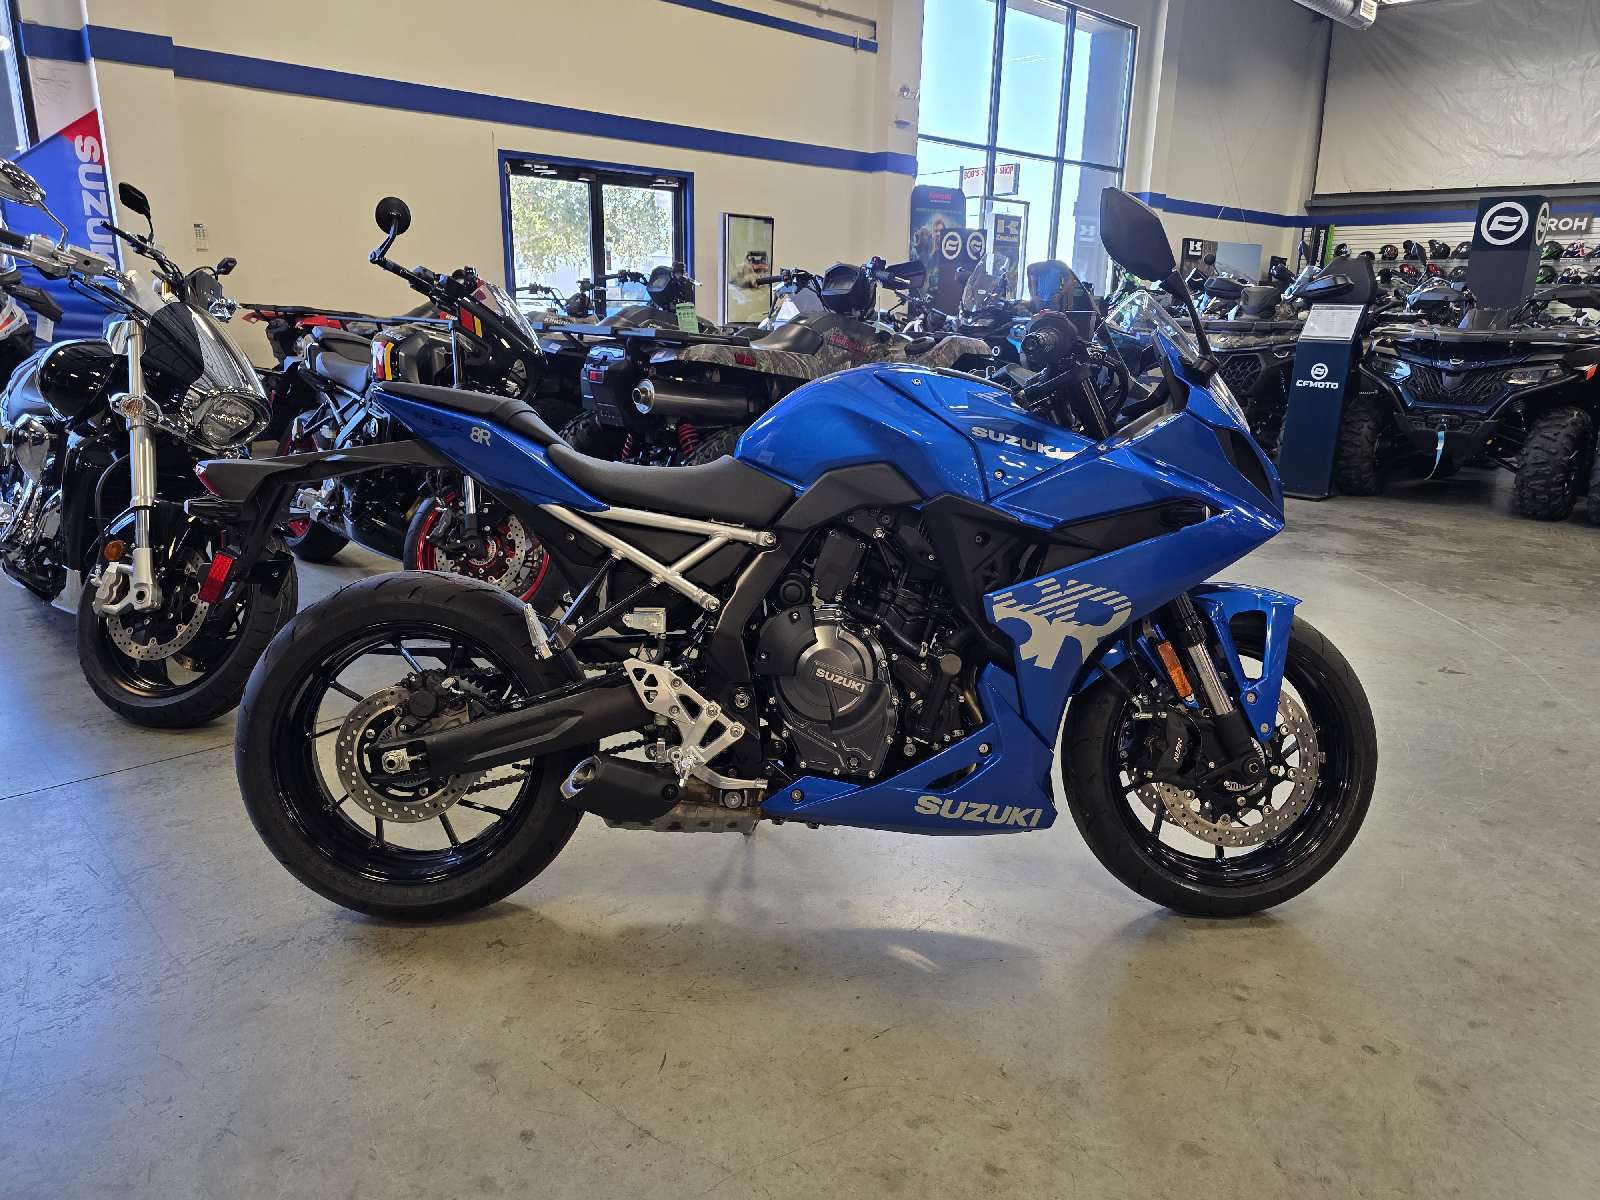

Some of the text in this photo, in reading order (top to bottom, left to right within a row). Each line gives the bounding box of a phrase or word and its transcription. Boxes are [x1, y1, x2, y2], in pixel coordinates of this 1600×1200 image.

[74, 134, 117, 271] SUZUK
[1546, 216, 1589, 232] ROH
[1296, 379, 1339, 390] CFMOTO
[470, 426, 492, 447] 8R
[815, 668, 866, 693] SUZUKI
[914, 795, 1043, 827] SUZUKI
